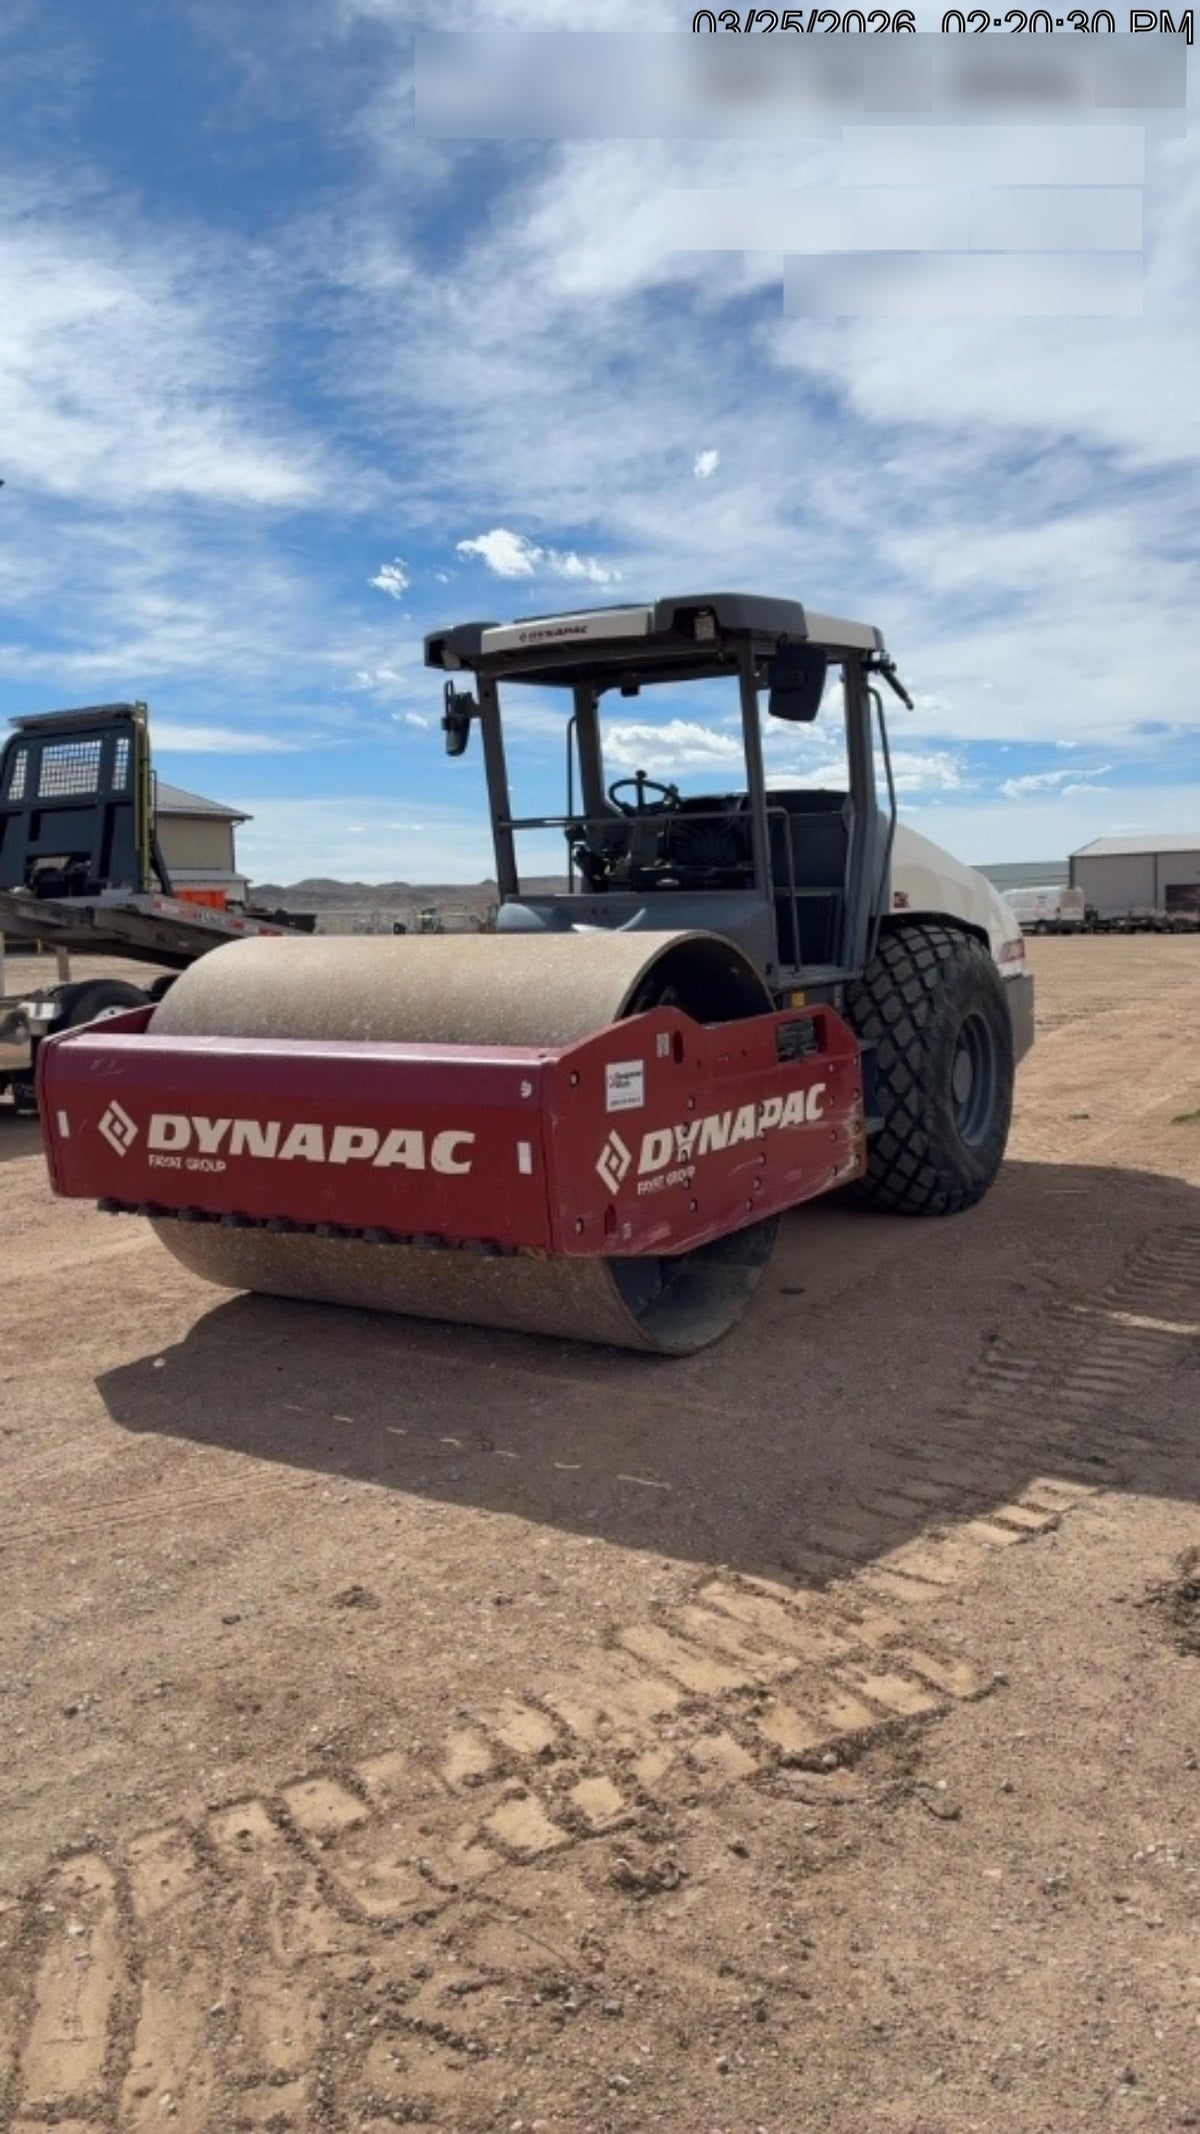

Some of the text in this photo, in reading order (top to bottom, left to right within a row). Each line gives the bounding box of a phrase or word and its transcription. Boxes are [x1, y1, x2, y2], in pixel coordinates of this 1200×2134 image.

[147, 1113, 476, 1175] DYNAPAC
[637, 1083, 826, 1175] DYNAPAC
[185, 1157, 226, 1172] GROUP
